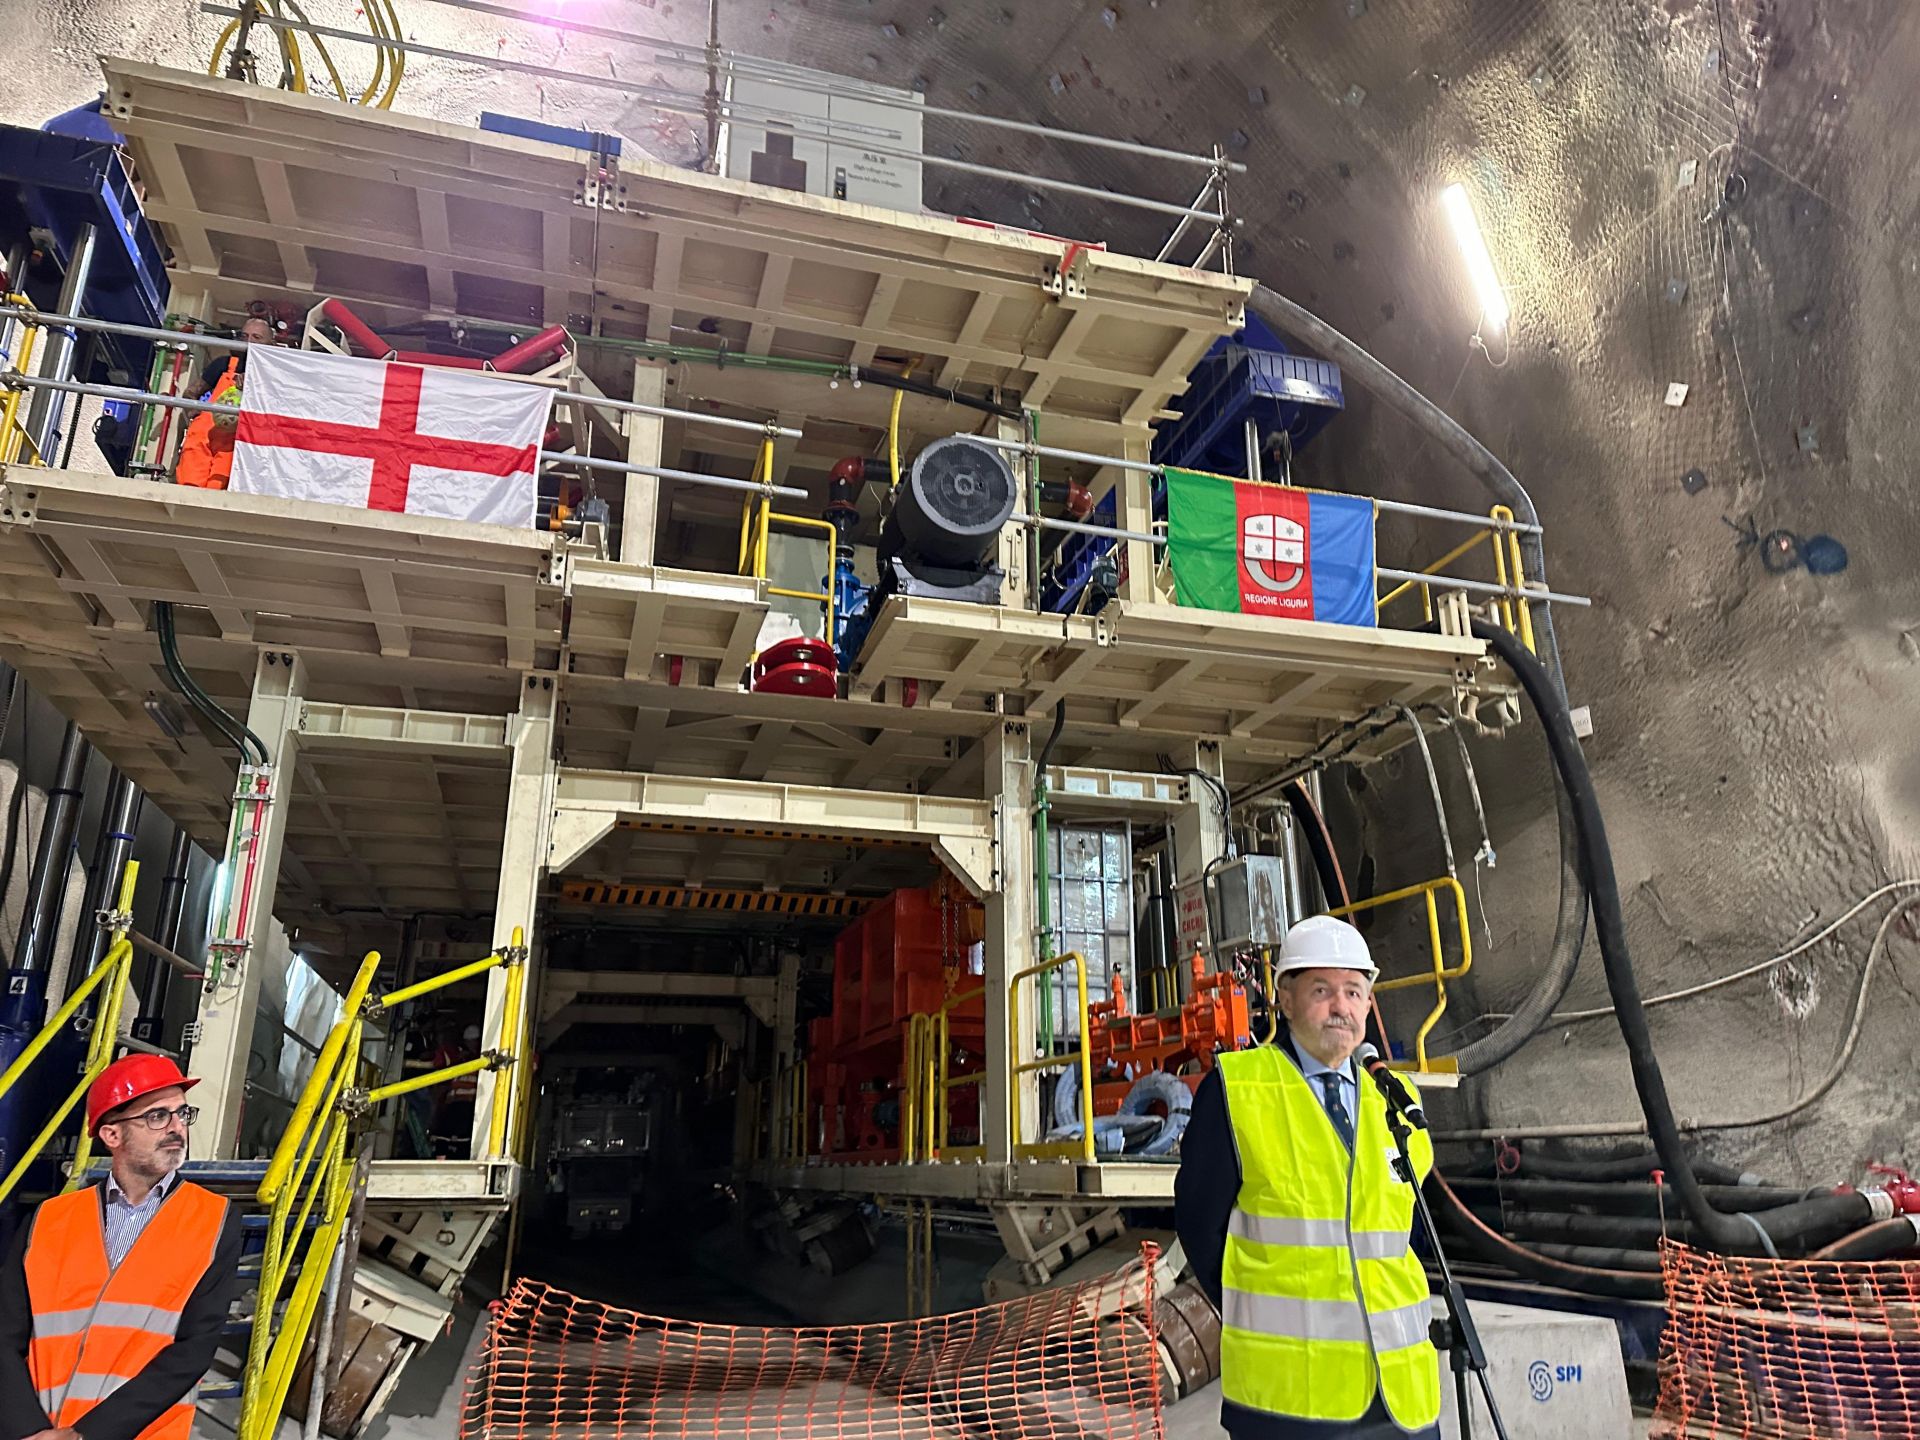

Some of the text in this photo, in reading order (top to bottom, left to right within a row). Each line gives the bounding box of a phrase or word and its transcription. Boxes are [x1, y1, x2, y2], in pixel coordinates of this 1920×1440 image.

[1244, 593, 1308, 608] REGIONE LIGURIA
[11, 978, 24, 992] 4
[139, 1025, 148, 1036] 4
[1556, 1364, 1582, 1382] SPI
